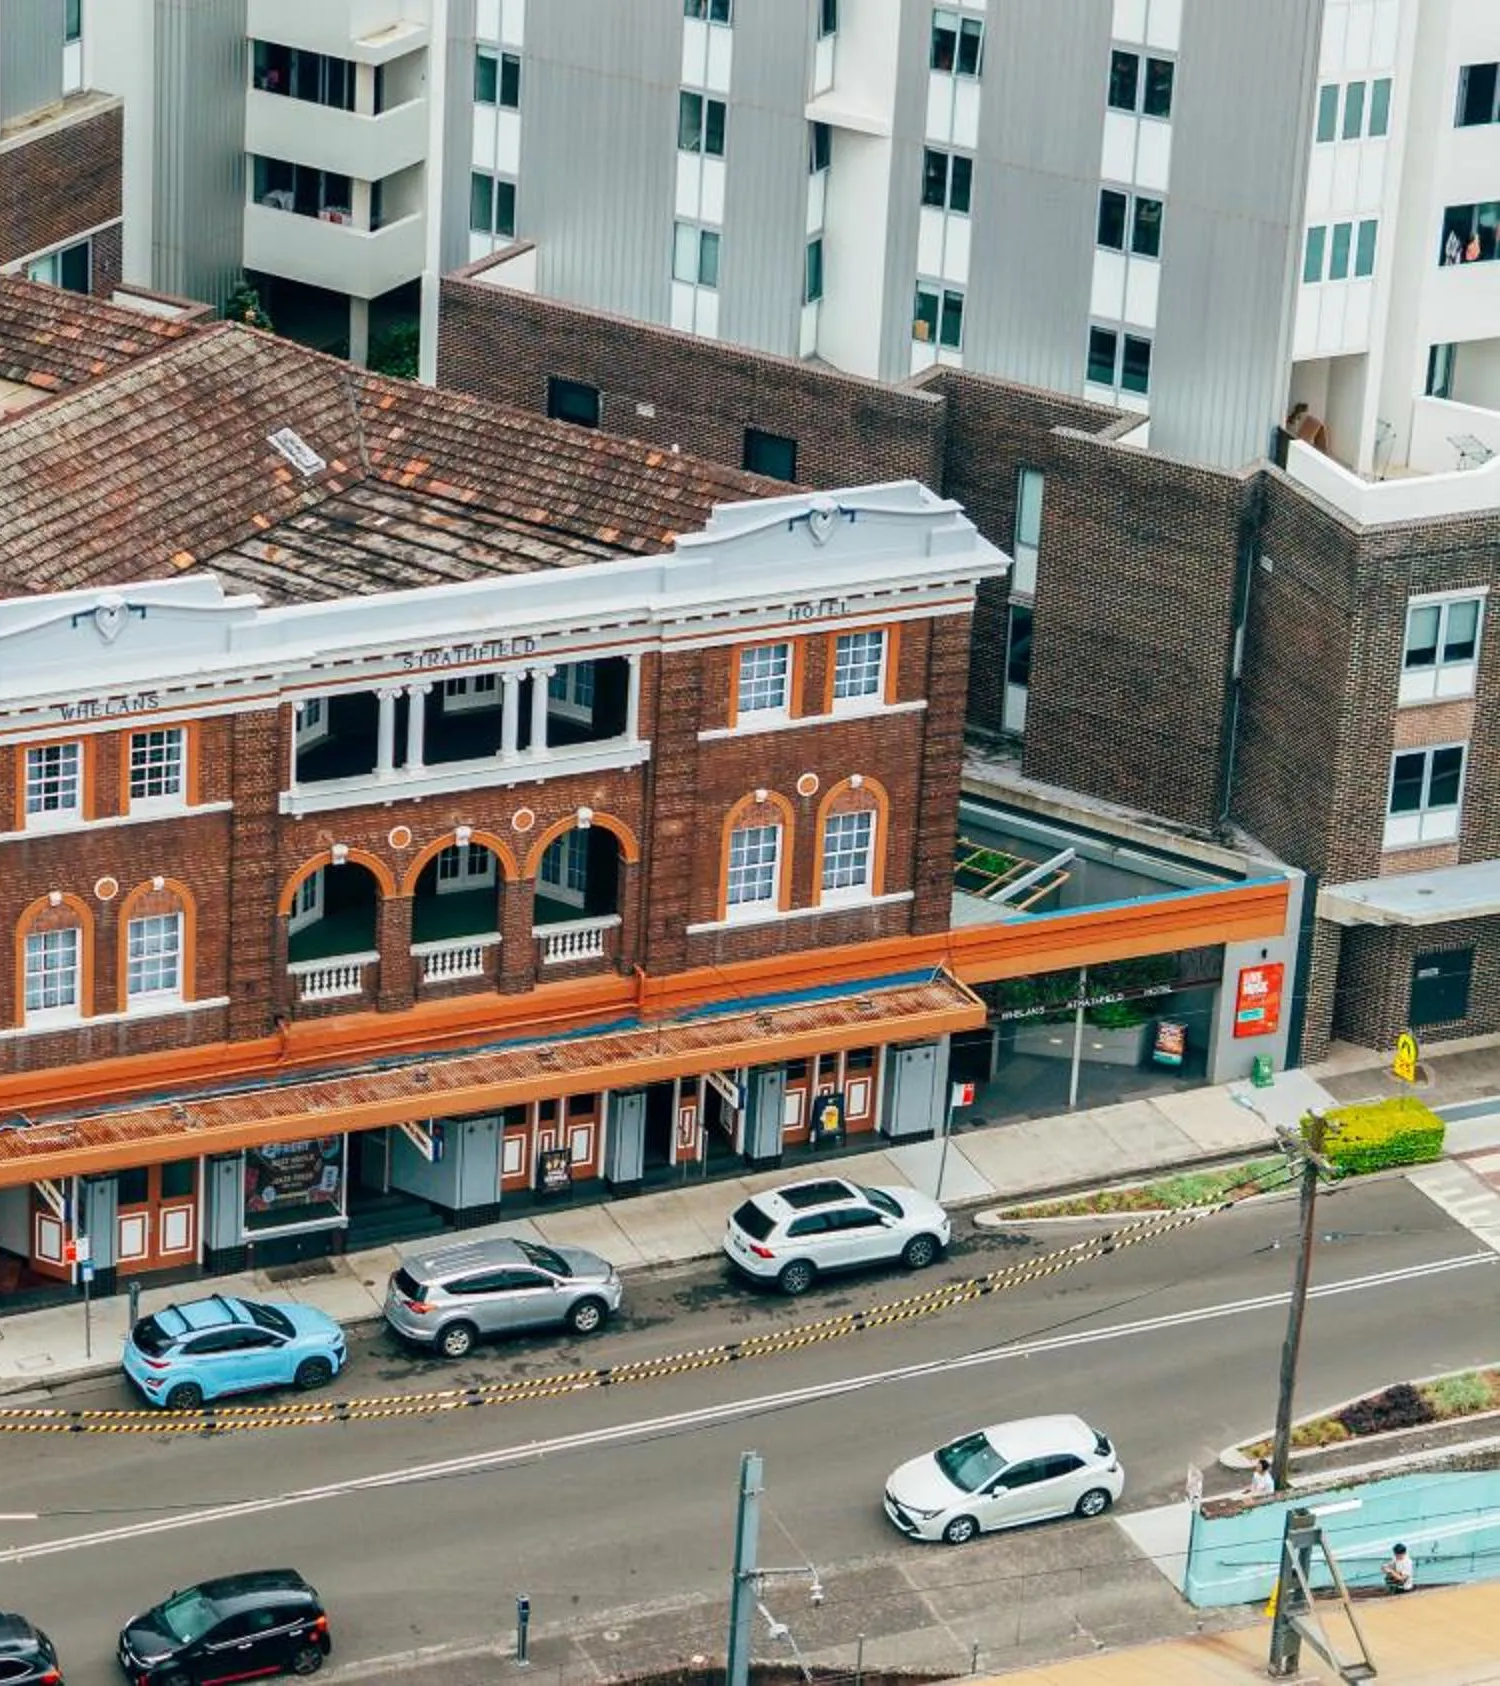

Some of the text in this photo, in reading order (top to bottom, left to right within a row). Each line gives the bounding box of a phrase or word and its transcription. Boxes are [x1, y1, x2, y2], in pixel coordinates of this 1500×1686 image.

[788, 600, 851, 620] HOTEL
[403, 638, 535, 668] STRATHFIELD
[60, 695, 159, 720] WHELANS
